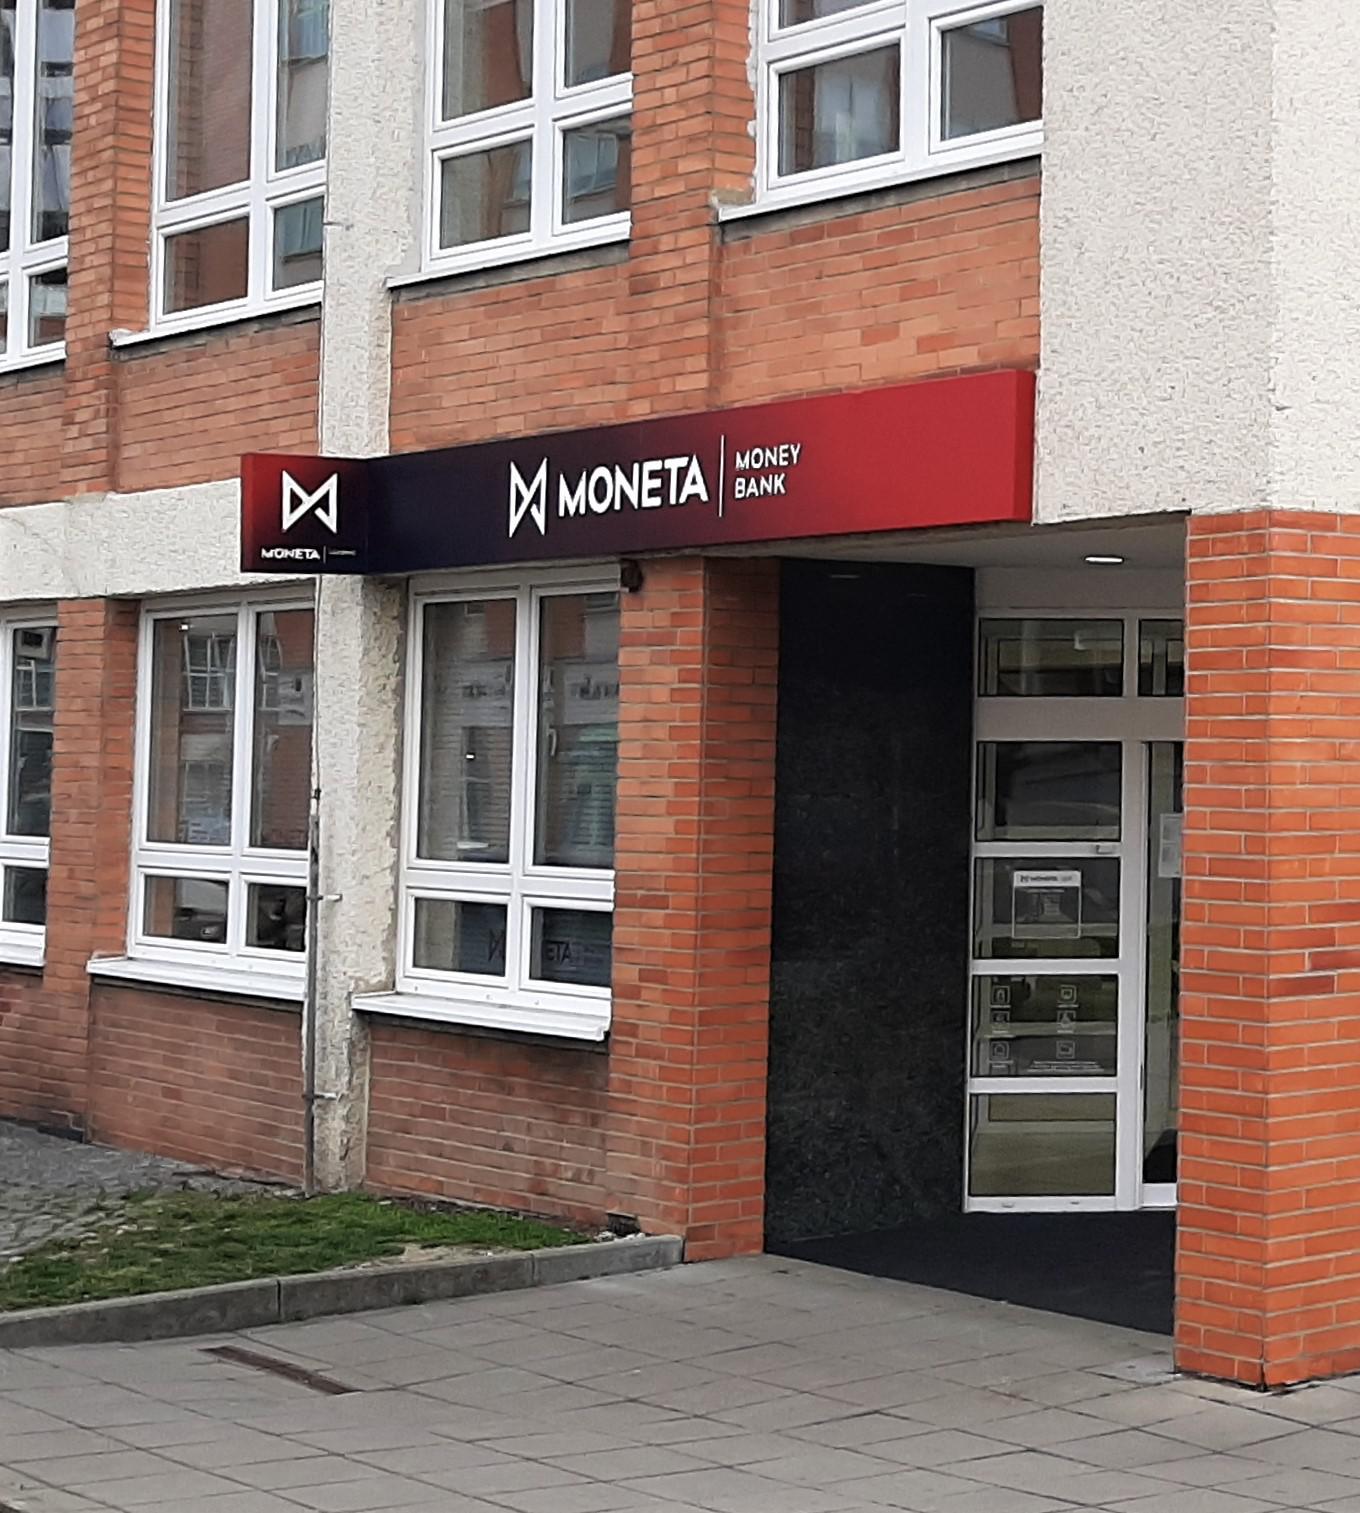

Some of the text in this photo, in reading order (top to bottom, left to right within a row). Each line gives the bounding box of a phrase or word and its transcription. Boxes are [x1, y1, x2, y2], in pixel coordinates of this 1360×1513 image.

[735, 442, 801, 471] MONEY
[558, 454, 709, 517] MONETA
[734, 472, 786, 499] BANK
[261, 547, 321, 560] MONETA
